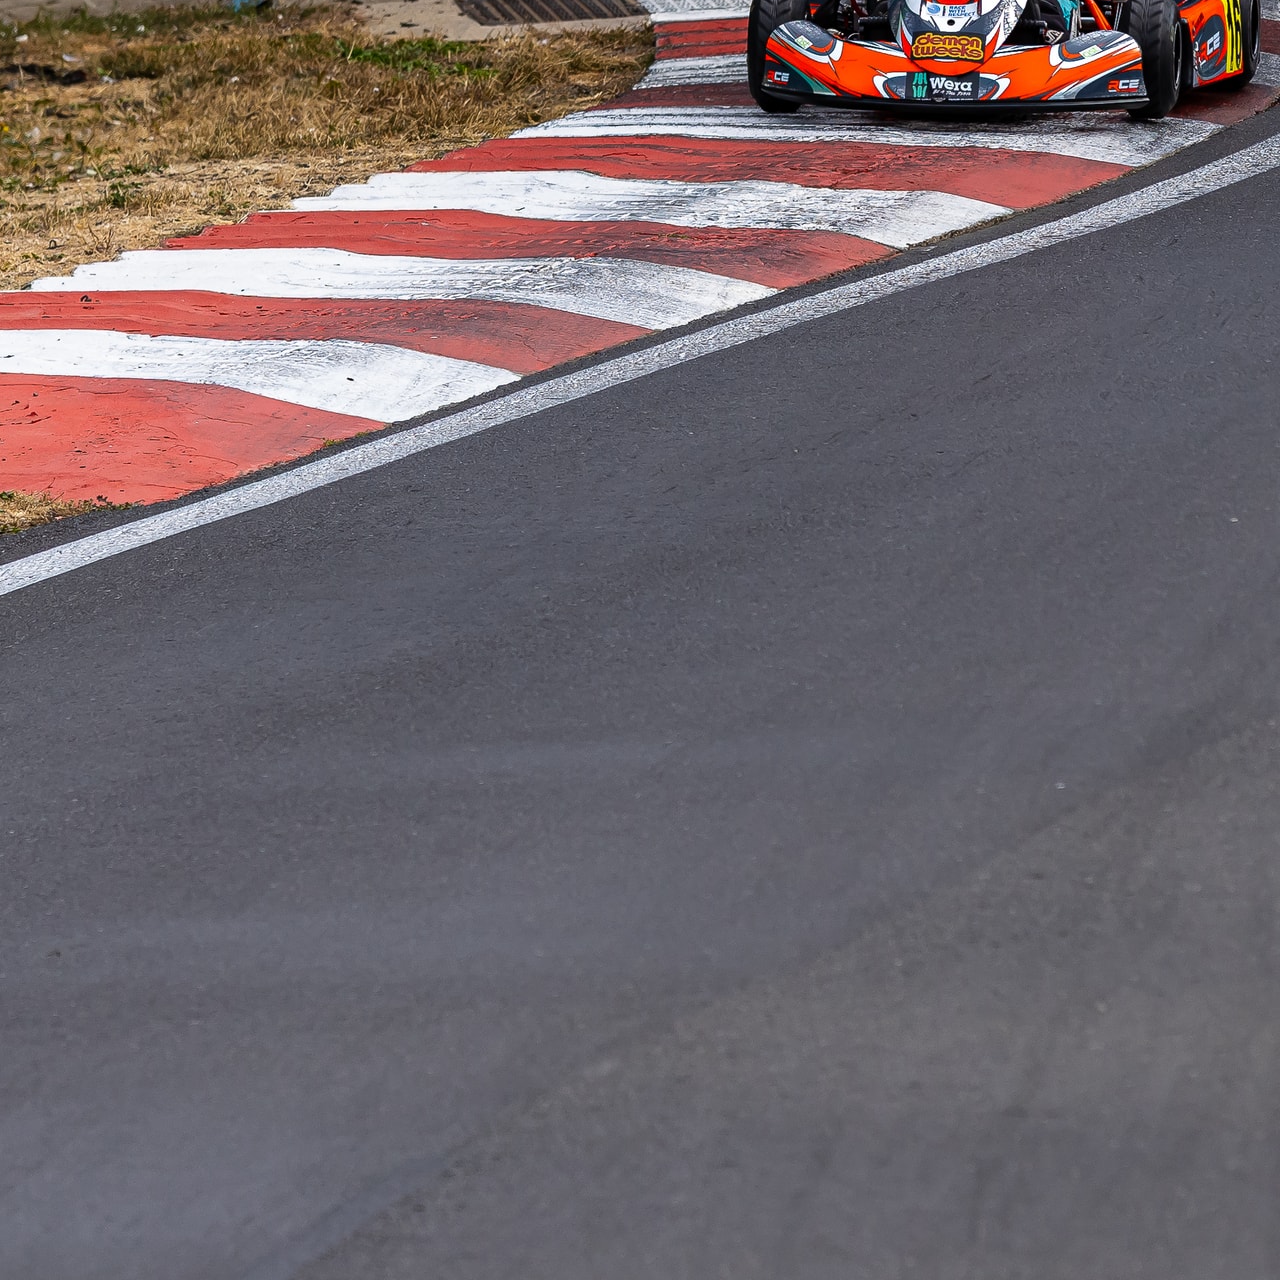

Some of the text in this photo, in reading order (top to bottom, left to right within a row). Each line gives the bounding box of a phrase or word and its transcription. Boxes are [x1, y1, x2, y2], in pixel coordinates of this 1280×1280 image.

[916, 33, 982, 49] demon
[913, 44, 983, 60] tweeks
[930, 78, 972, 91] Wera
